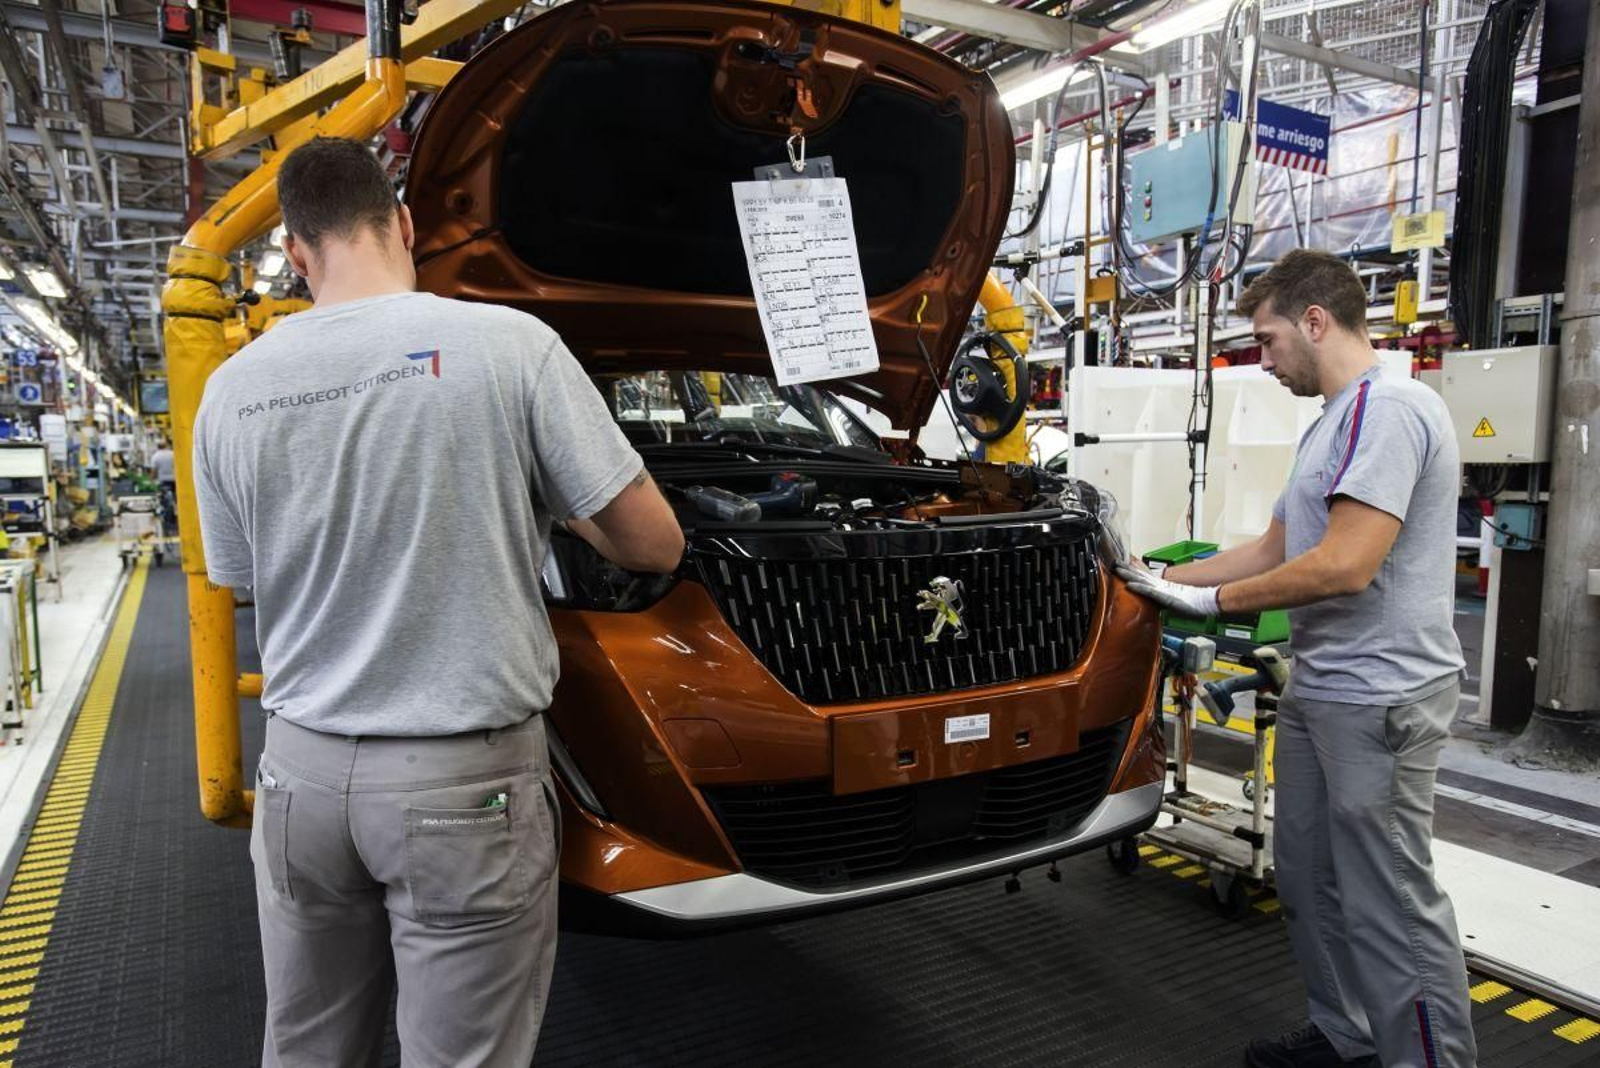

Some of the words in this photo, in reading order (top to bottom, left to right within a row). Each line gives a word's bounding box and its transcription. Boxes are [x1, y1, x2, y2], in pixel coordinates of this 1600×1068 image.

[1258, 124, 1275, 138] me
[1277, 127, 1325, 153] arriesgo
[17, 351, 37, 366] 53
[238, 402, 265, 420] PSA
[268, 386, 351, 410] PEUGEOT
[353, 364, 425, 394] CITROËN
